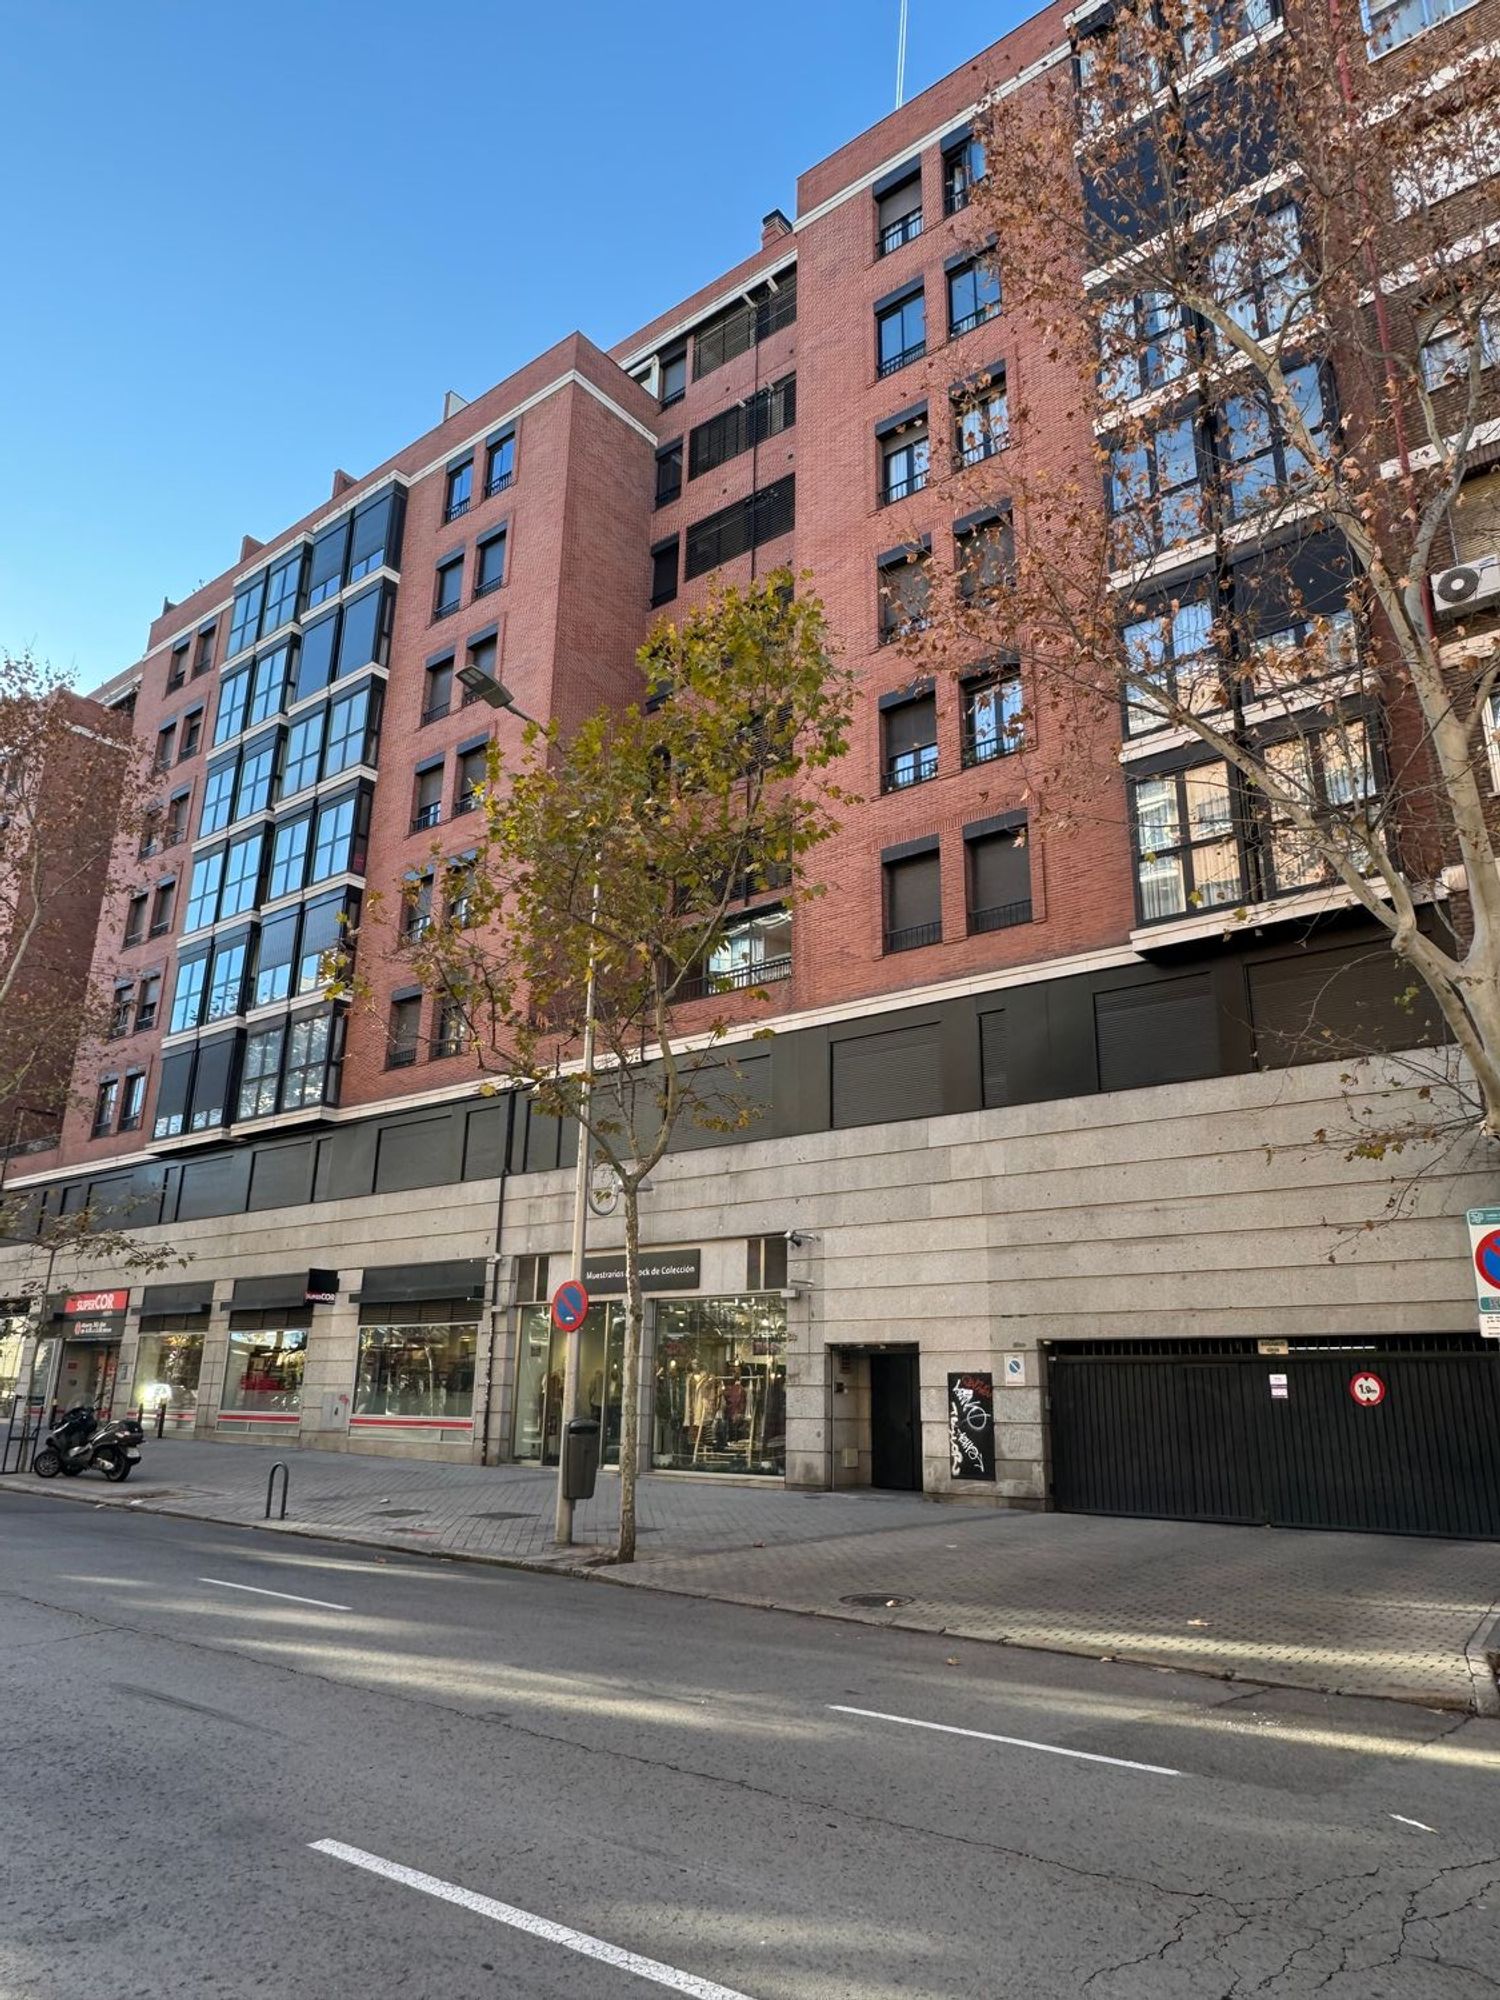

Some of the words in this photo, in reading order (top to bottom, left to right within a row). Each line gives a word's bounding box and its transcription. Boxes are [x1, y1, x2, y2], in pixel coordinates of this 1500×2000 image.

[586, 1270, 624, 1280] Muestrarios
[651, 1266, 660, 1276] de
[661, 1264, 696, 1275] Colección
